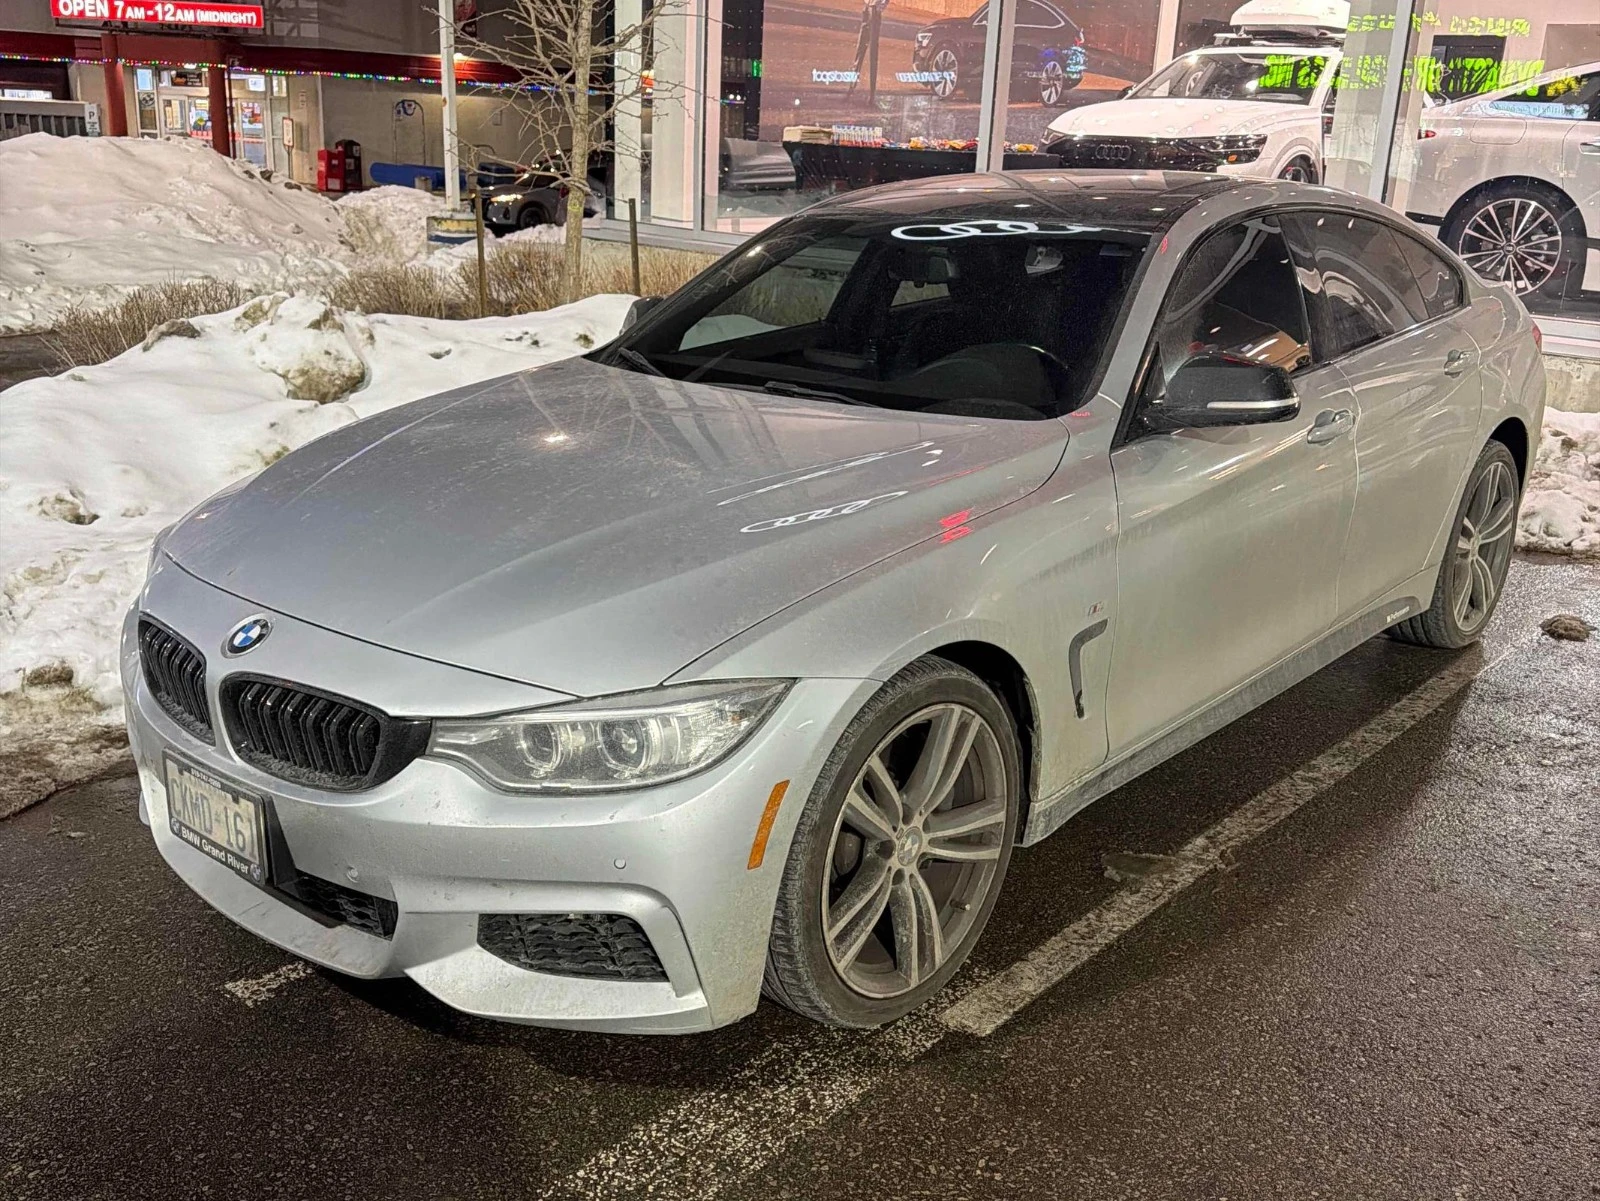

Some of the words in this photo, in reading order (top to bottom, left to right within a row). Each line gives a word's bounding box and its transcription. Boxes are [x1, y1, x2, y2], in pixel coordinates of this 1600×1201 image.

[58, 0, 109, 17] OPEN
[196, 9, 257, 26] (MIDNIGHT)
[88, 111, 95, 119] P
[181, 827, 200, 847] BMW
[202, 839, 226, 861] Grand
[227, 853, 249, 874] River
